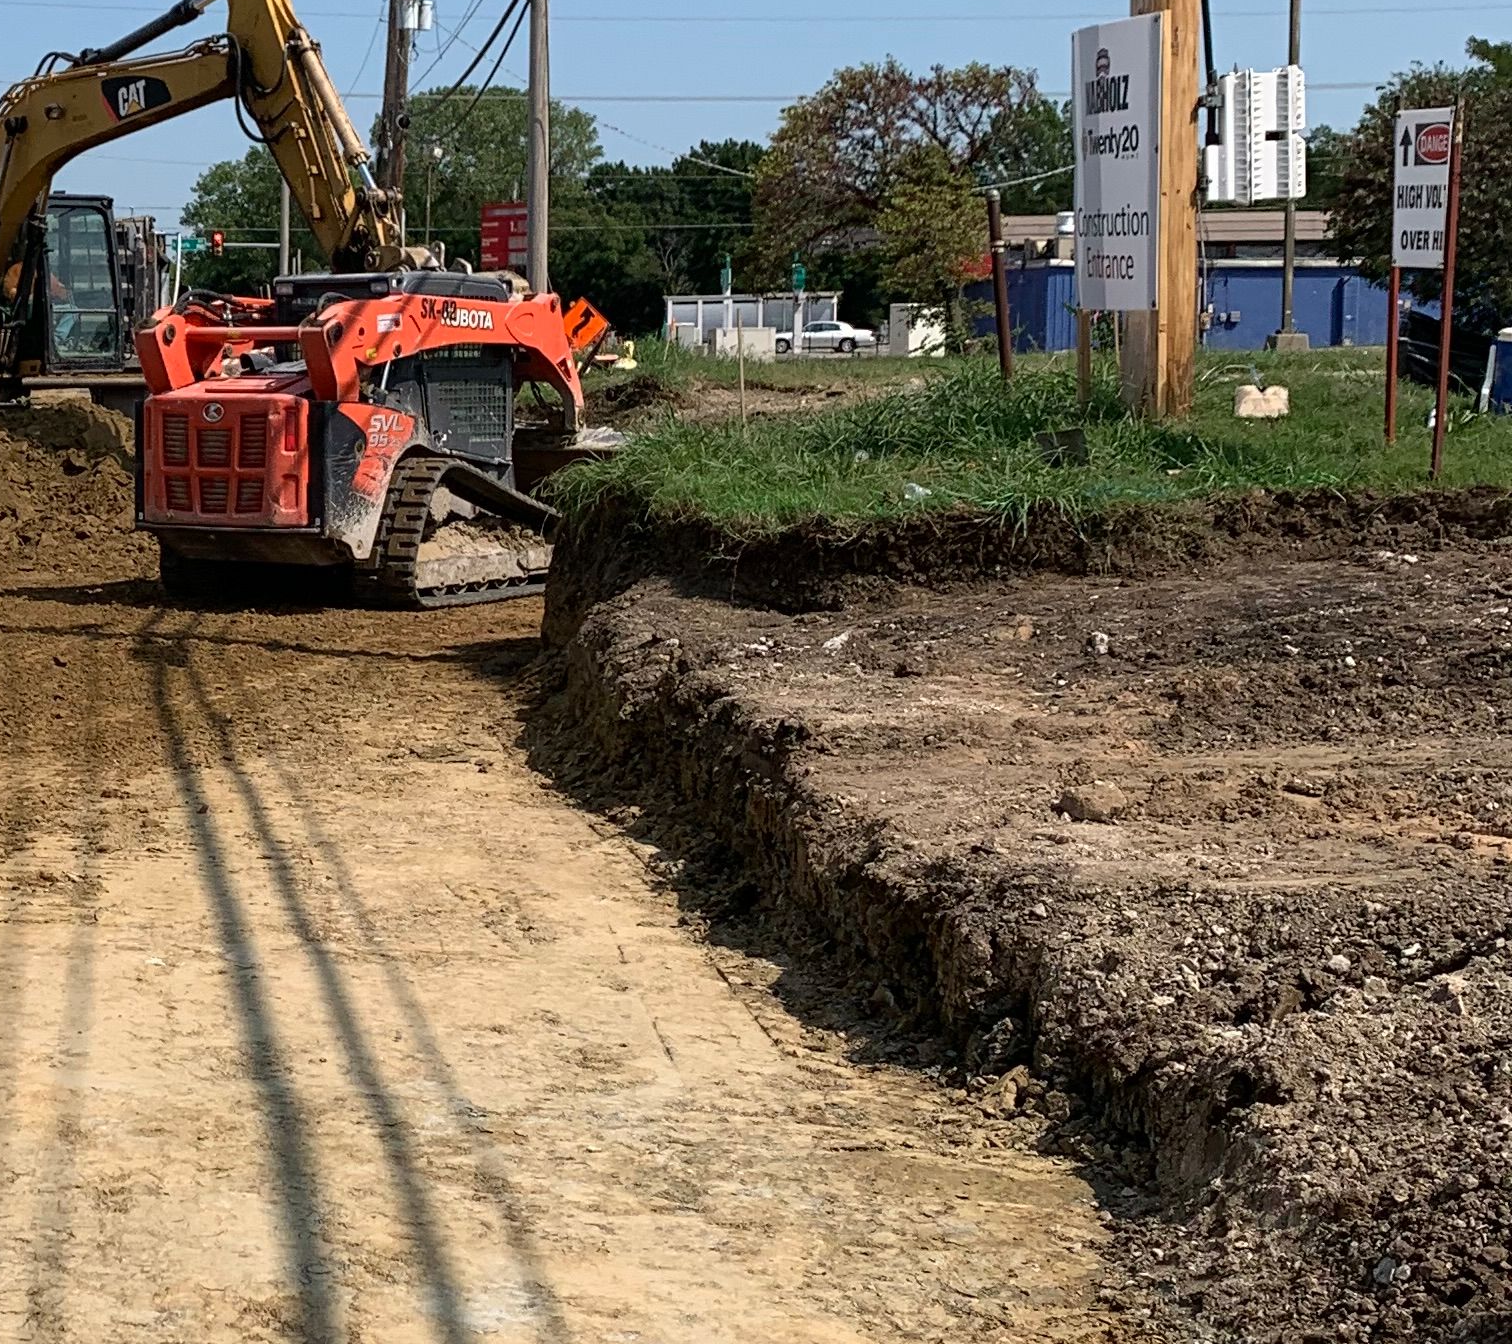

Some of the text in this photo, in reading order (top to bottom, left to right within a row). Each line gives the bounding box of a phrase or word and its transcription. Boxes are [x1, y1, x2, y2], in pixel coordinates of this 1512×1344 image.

[118, 79, 146, 116] CAT
[1420, 134, 1448, 152] DANGE
[1397, 185, 1423, 209] HIGH
[1077, 203, 1149, 237] Construction
[1400, 230, 1443, 251] OVER HI
[1087, 247, 1134, 280] Entrance
[368, 414, 405, 433] SVL
